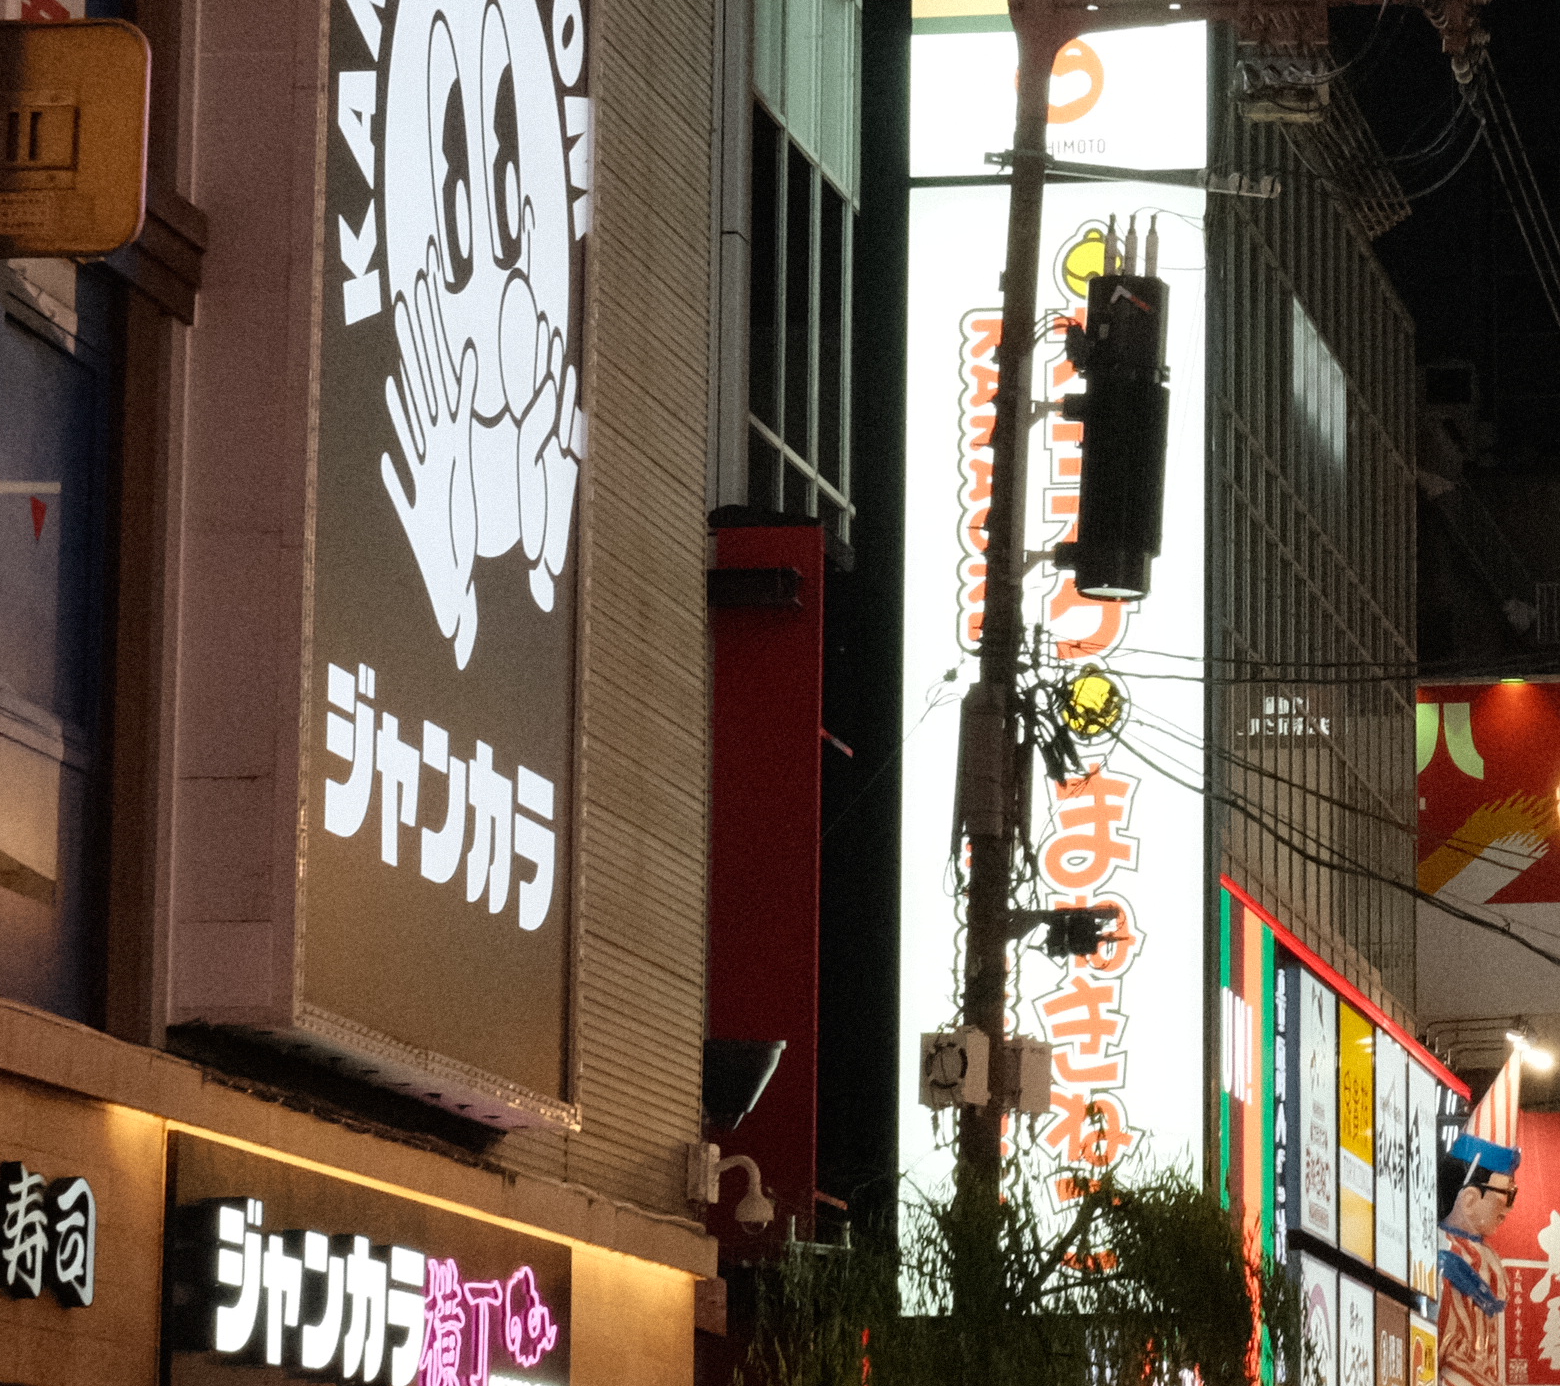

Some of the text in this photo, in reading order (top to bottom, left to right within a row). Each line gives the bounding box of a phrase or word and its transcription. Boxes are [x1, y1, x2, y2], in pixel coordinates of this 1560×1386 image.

[324, 661, 556, 933] ジャンカラ
